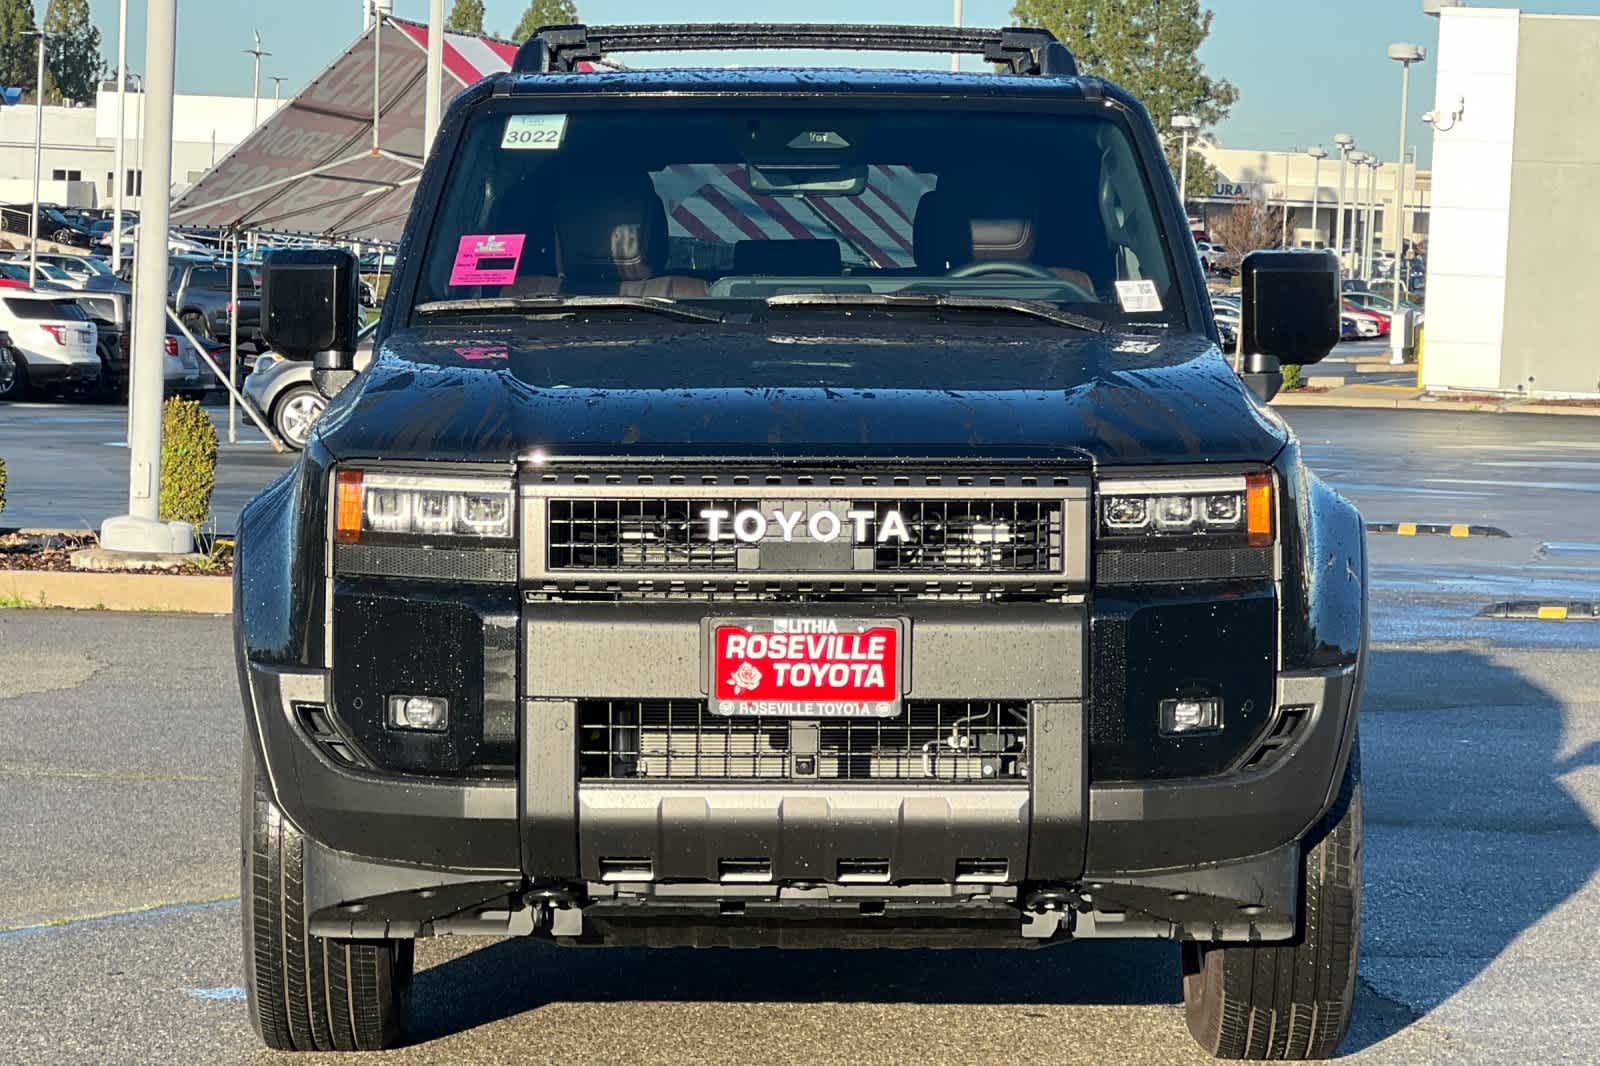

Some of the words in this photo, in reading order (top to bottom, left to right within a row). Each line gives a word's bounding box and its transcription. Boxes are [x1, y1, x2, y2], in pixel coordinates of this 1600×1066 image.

[506, 130, 558, 143] 3022
[1215, 183, 1243, 196] URA
[700, 508, 910, 543] TOYOTA
[789, 619, 838, 634] LITHIA
[725, 635, 887, 660] ROSEVILLE
[772, 663, 886, 688] TOYOTA
[739, 702, 814, 715] ROSEVILLE
[815, 702, 871, 716] TOYOTA
